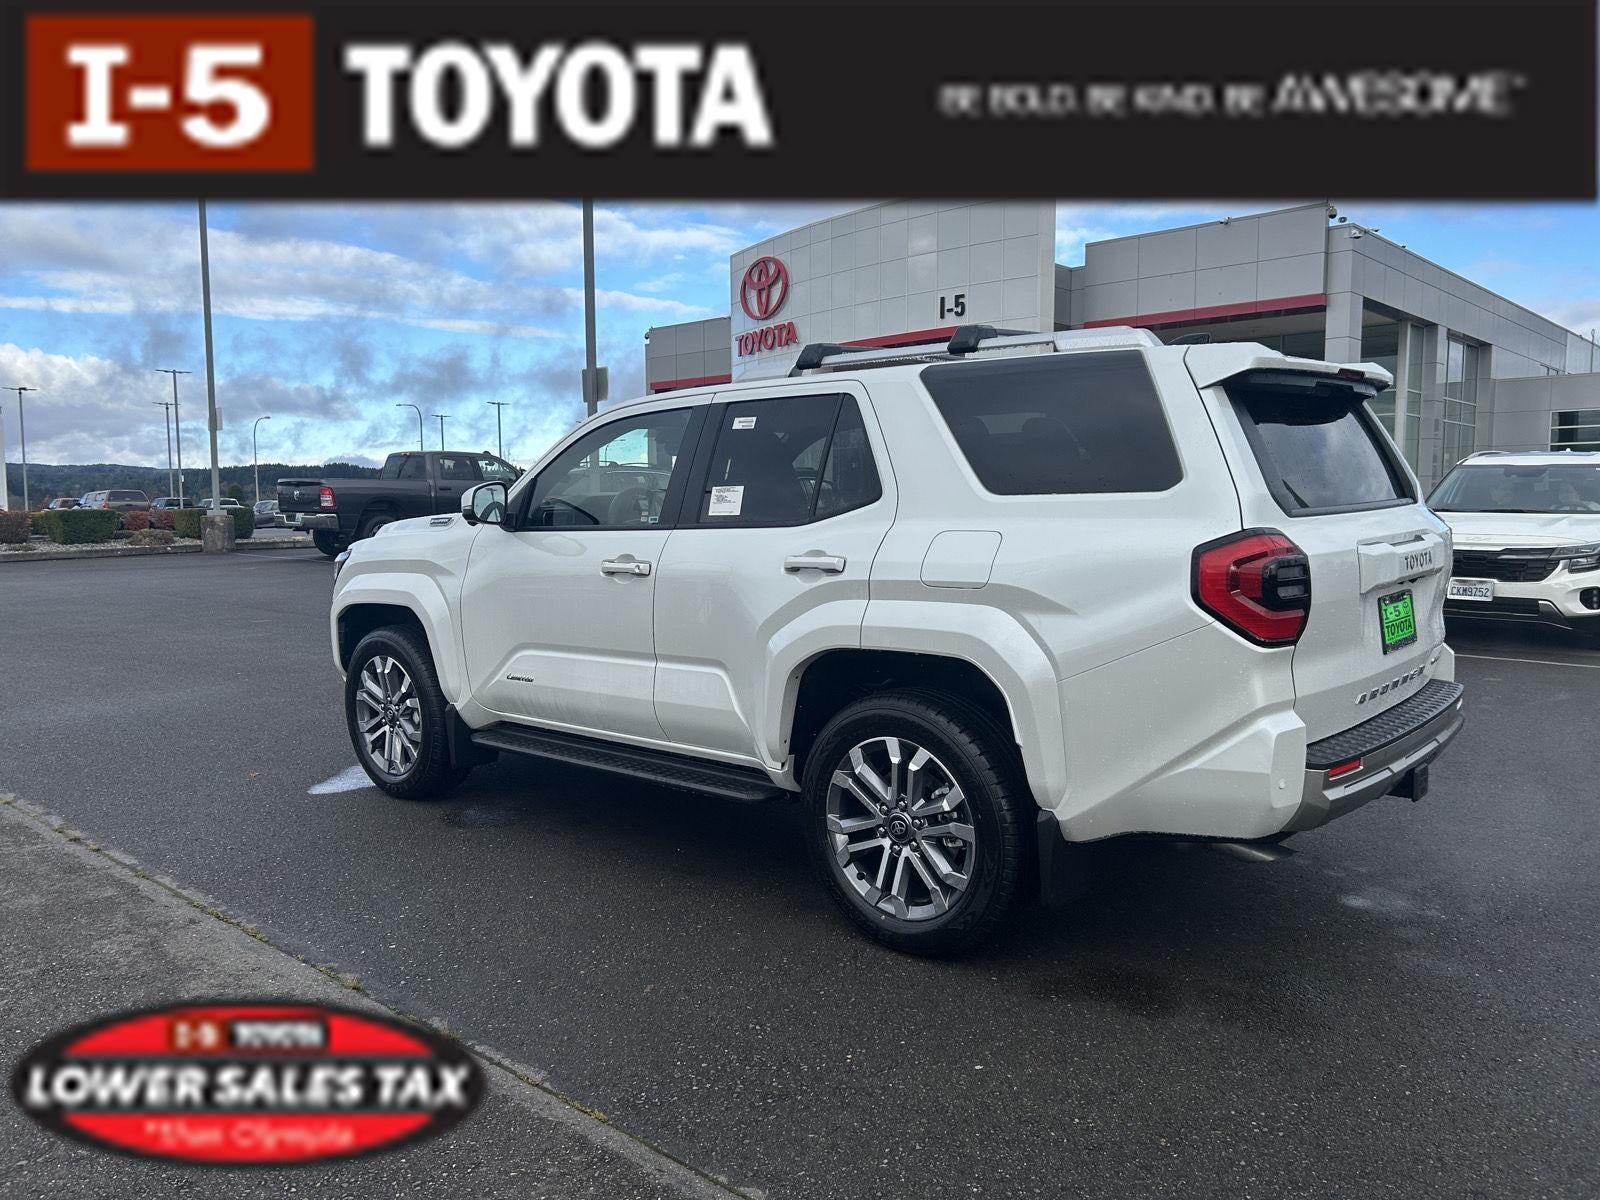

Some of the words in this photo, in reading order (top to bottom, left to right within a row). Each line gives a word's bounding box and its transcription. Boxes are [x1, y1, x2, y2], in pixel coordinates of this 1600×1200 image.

[939, 294, 966, 320] I-5
[735, 321, 799, 358] TOYOTA
[1404, 550, 1433, 571] TOYOTA
[1450, 585, 1490, 598] CKM9752
[1383, 604, 1401, 621] I-5
[1385, 618, 1413, 638] TOYOTA
